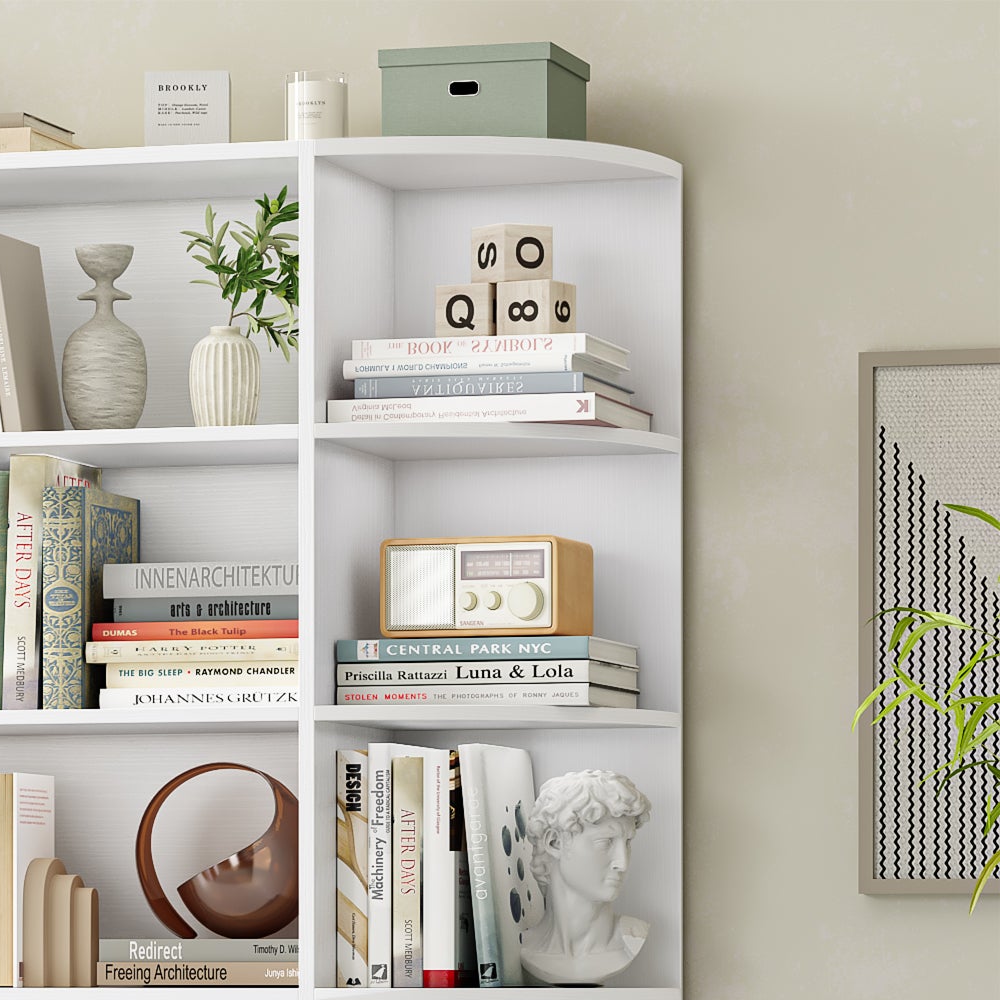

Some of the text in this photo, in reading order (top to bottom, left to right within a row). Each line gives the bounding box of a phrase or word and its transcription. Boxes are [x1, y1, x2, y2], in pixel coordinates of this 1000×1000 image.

[158, 84, 208, 92] BROOKLY
[446, 294, 475, 330] Q
[508, 299, 538, 322] 8
[14, 512, 32, 609] AFTER DAYS
[170, 602, 191, 617] arts
[208, 600, 271, 616] architecture
[102, 629, 138, 637] DUMAS
[169, 628, 247, 637] The Black Tulip
[386, 642, 552, 656] CENTRAL PARK NYC
[15, 636, 26, 702] SCOTT MEDBURY
[119, 669, 135, 677] THE
[138, 669, 154, 677] BIG
[195, 667, 295, 676] RAYMOND CHANDLER
[345, 669, 448, 681] Priscilla Rattazzi
[456, 664, 574, 680] Luna & Lola
[345, 693, 378, 701] STOLEN
[384, 692, 427, 700] MOMENTS
[433, 692, 448, 700] THE
[451, 692, 504, 700] PHOTOGRAPHS
[345, 764, 362, 812] DESIGN
[371, 770, 384, 826] Freedom
[400, 809, 415, 895] AFTER DAYS
[371, 837, 387, 901] Machinery
[129, 941, 183, 960] Redirect
[403, 919, 413, 979] SCOTT MEDBURY
[105, 964, 227, 984] Freeing Architecture
